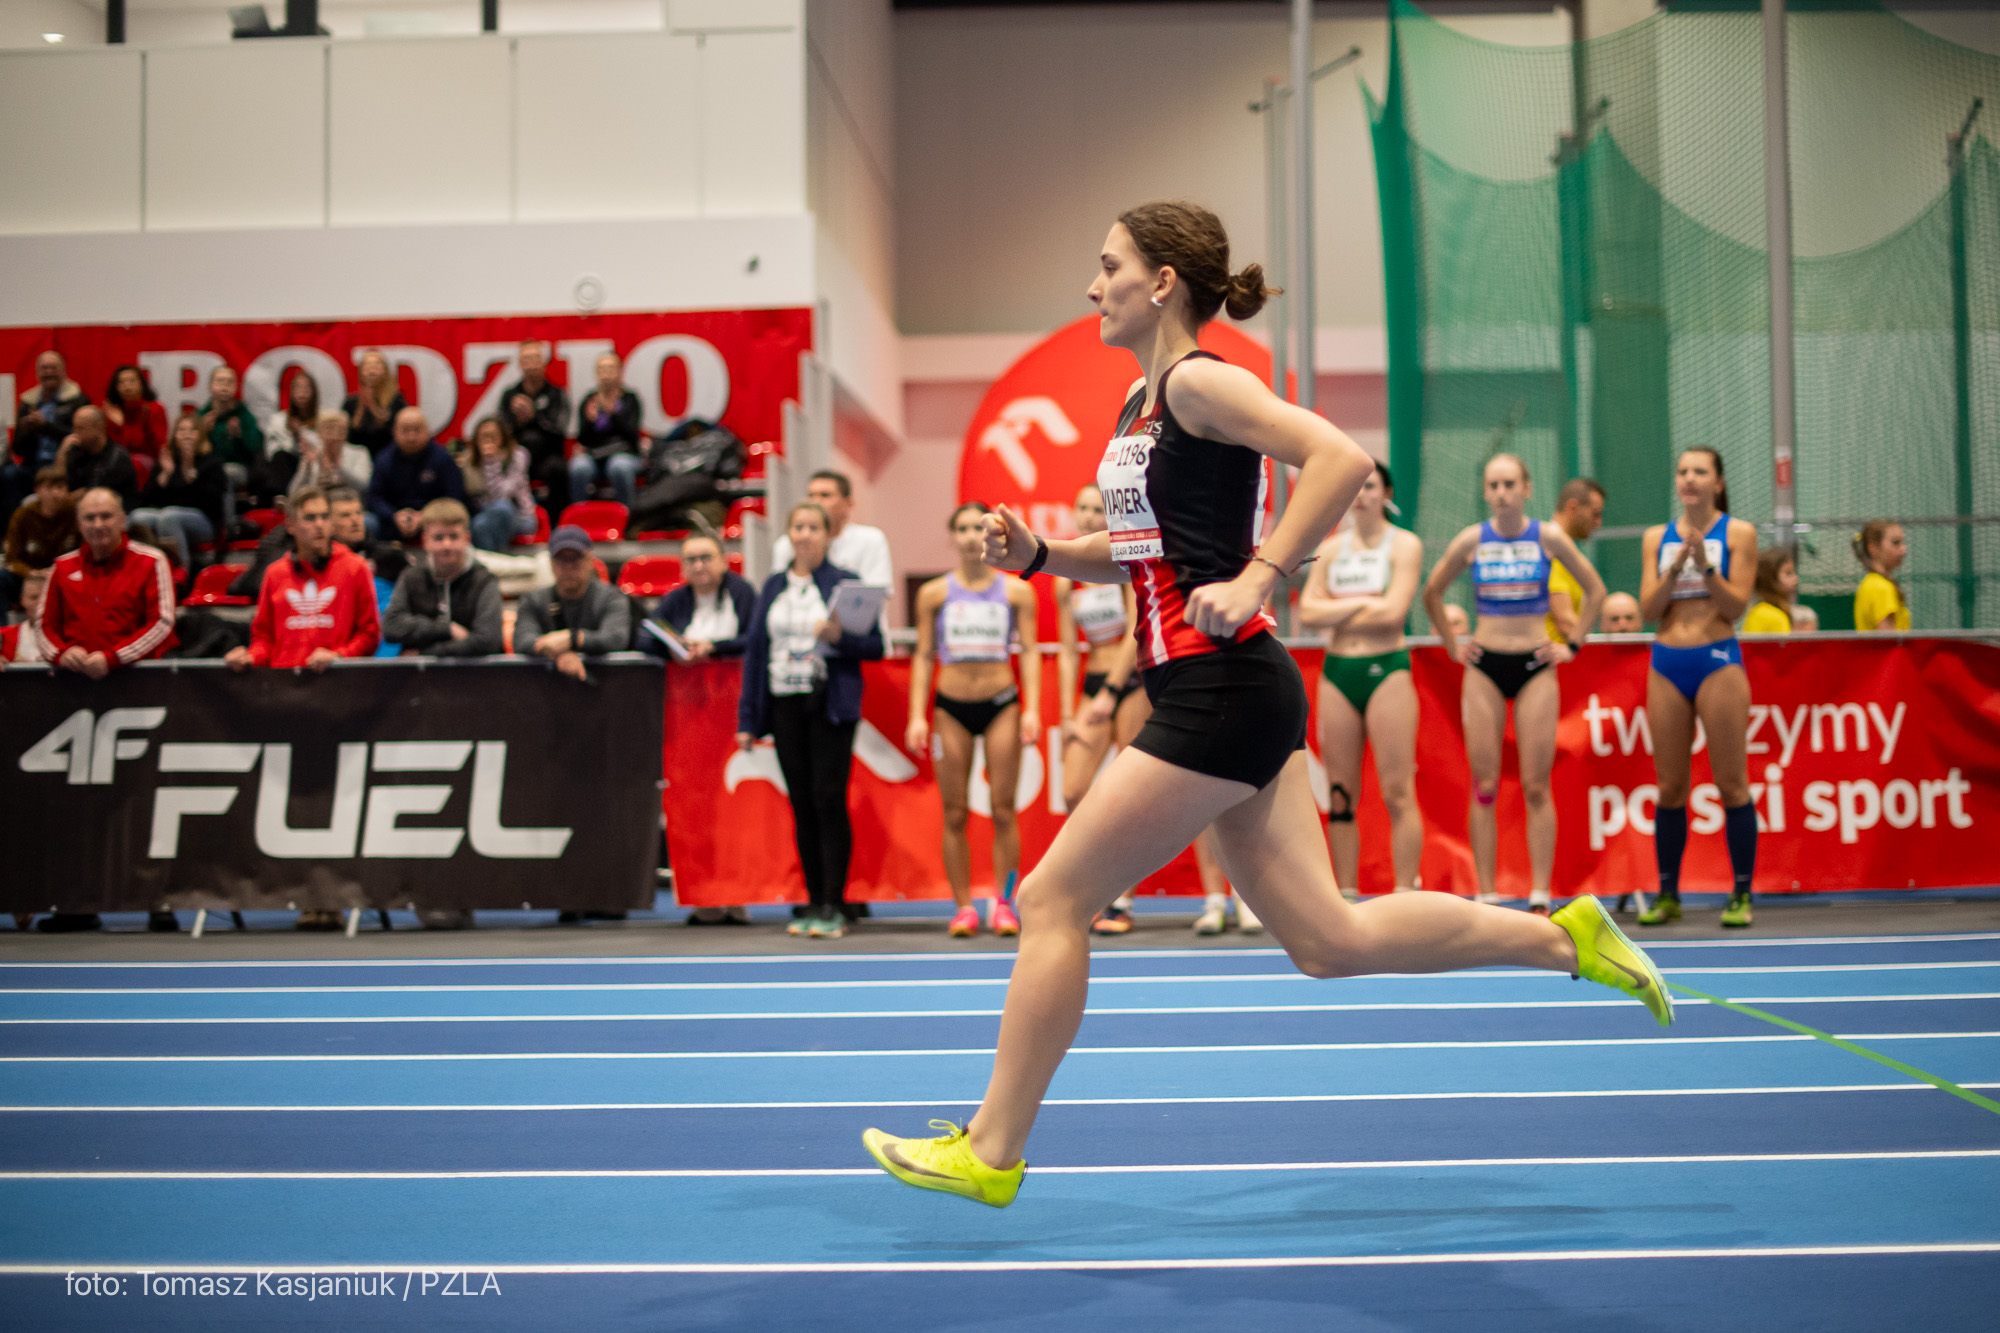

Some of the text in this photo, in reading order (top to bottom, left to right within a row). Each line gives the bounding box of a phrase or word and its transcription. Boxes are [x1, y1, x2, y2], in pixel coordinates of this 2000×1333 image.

[1117, 443, 1147, 466] 1196
[1128, 544, 1151, 555] 2024
[1583, 693, 1906, 767] twzymy
[18, 706, 573, 859] 4F FUEL
[1588, 763, 1973, 851] posi sport
